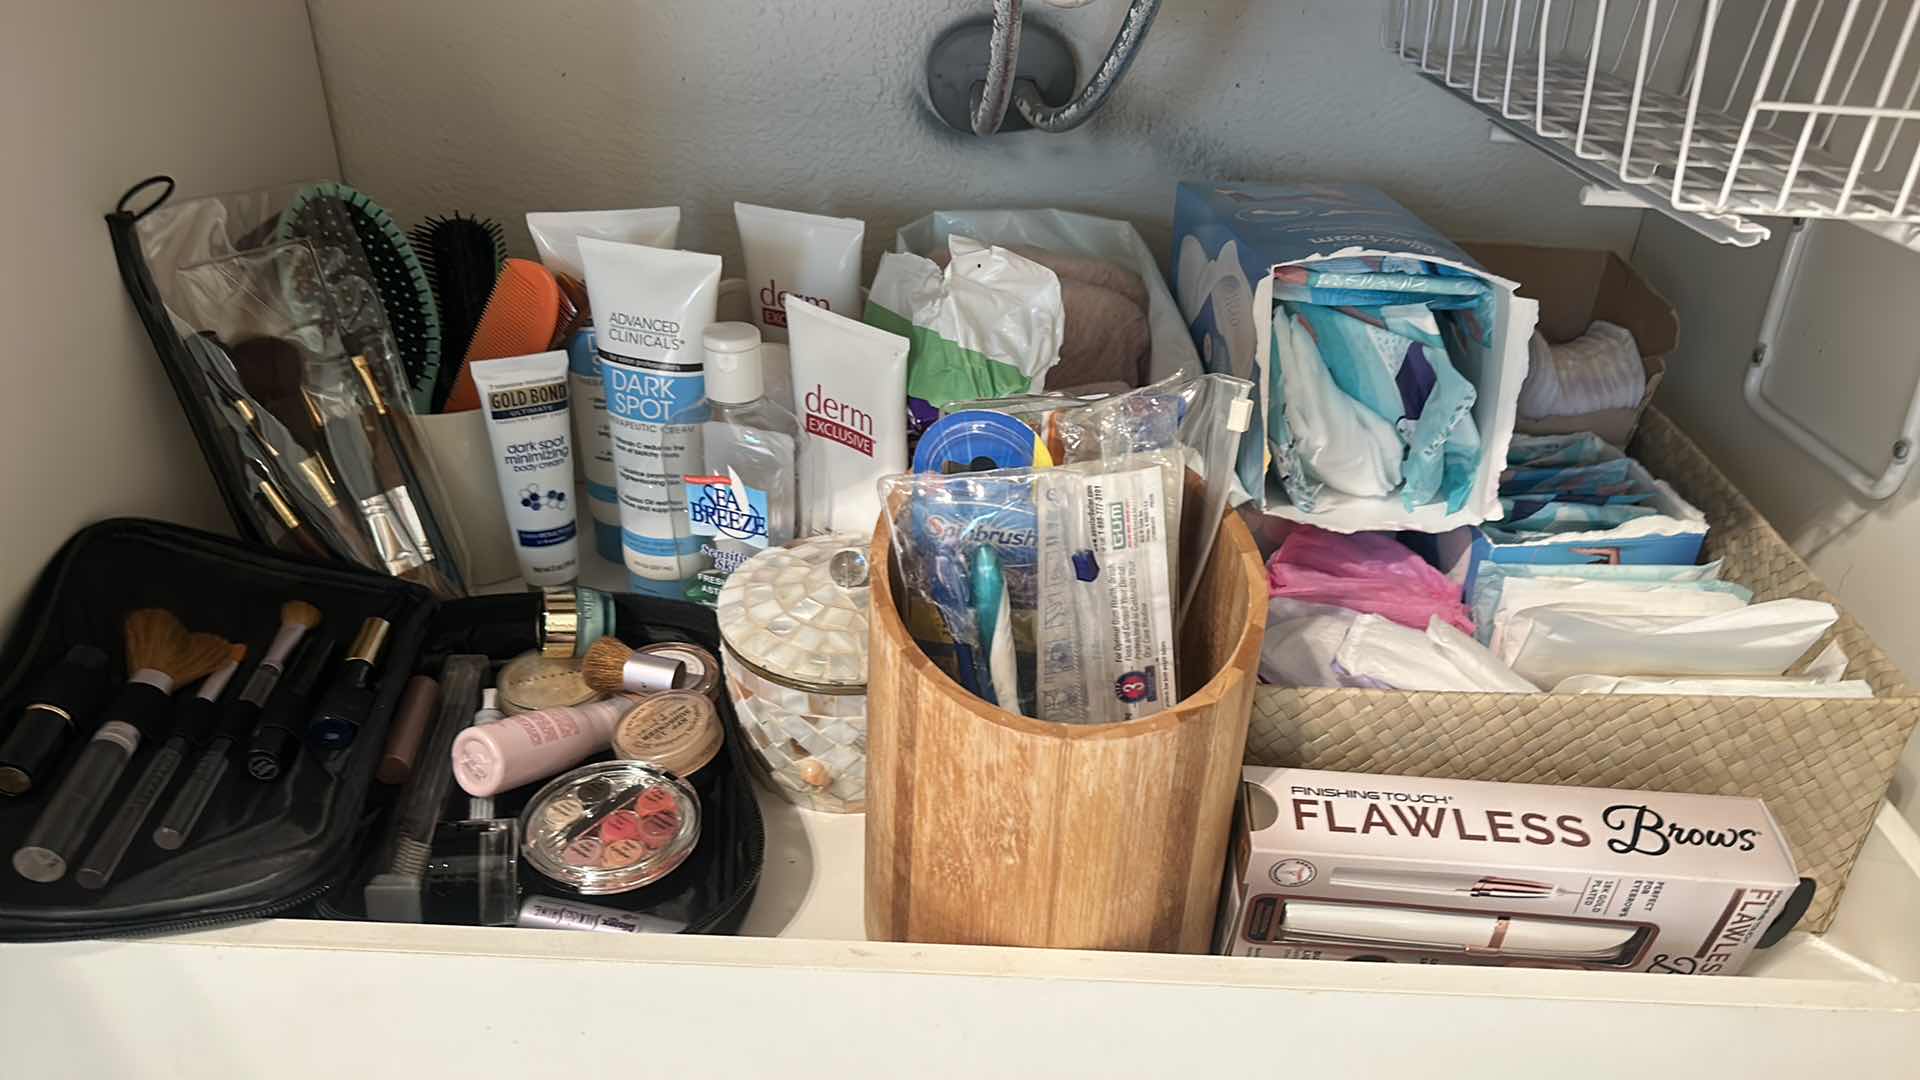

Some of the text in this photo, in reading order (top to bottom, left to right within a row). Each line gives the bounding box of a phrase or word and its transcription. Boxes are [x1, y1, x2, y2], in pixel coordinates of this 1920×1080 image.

[609, 312, 680, 333] ADVANCED
[491, 384, 568, 409] GOLD BOND
[611, 369, 677, 400] DARK
[615, 392, 675, 420] SPOT
[805, 384, 873, 436] derm
[506, 436, 565, 455] dark spot
[809, 417, 871, 454] EXCLUSIVE
[504, 446, 569, 465] minimizing
[513, 457, 566, 473] body cream
[700, 484, 742, 512] SEA
[690, 499, 766, 537] BREEZE
[701, 544, 751, 563] Sensiti
[714, 559, 737, 573] Ski
[697, 572, 725, 586] FRES
[1291, 786, 1449, 804] FINISHING TOUCH
[1292, 795, 1757, 856] FLAWLESS Brows
[1584, 880, 1603, 906] PLATED
[1619, 880, 1643, 917] EYEBROWS
[1640, 880, 1655, 894] FOR
[1644, 881, 1665, 911] PERFECT
[1591, 893, 1607, 913] GOLD
[1699, 888, 1775, 974] FLAWLES
